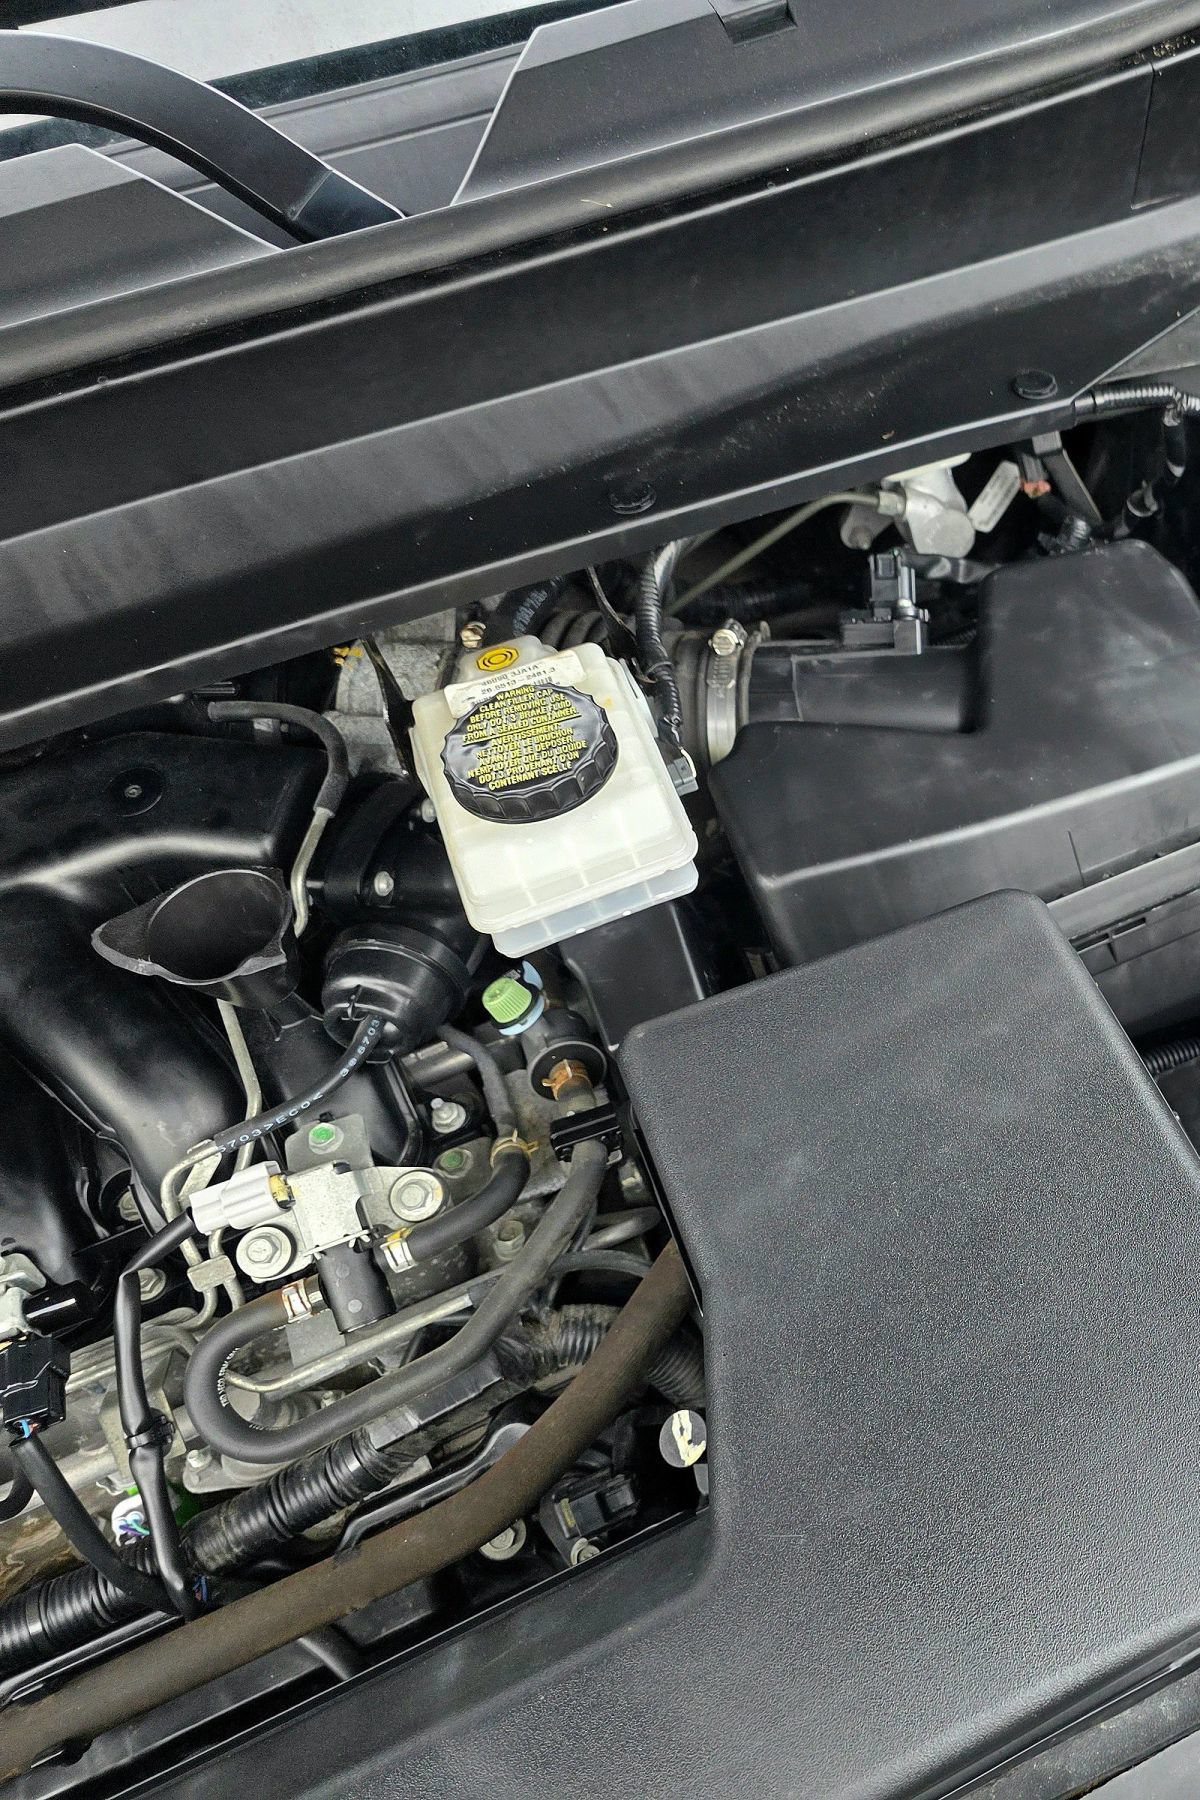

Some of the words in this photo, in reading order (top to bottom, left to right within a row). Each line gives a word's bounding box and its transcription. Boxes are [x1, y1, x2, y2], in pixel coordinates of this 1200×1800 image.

[470, 710, 501, 723] BEFORE
[550, 694, 565, 703] USE
[480, 701, 507, 713] CLEAN
[507, 694, 536, 706] FILLER
[467, 722, 488, 732] ONLY
[490, 717, 508, 727] DOT
[519, 707, 548, 719] BRAKE
[548, 700, 571, 712] FLUID
[463, 730, 487, 742] FROM
[498, 720, 529, 733] SEALED
[476, 742, 519, 759] NETTOYER
[523, 739, 532, 747] LE
[534, 728, 574, 744] BOUCHON
[523, 753, 541, 763] QUE
[542, 750, 554, 758] DU
[555, 741, 587, 755] LIQUIDE
[479, 753, 508, 766] AVANT
[511, 750, 522, 758] DE
[524, 747, 534, 755] LE
[506, 757, 558, 777] PROVENANT
[489, 770, 542, 790] CONTENANT
